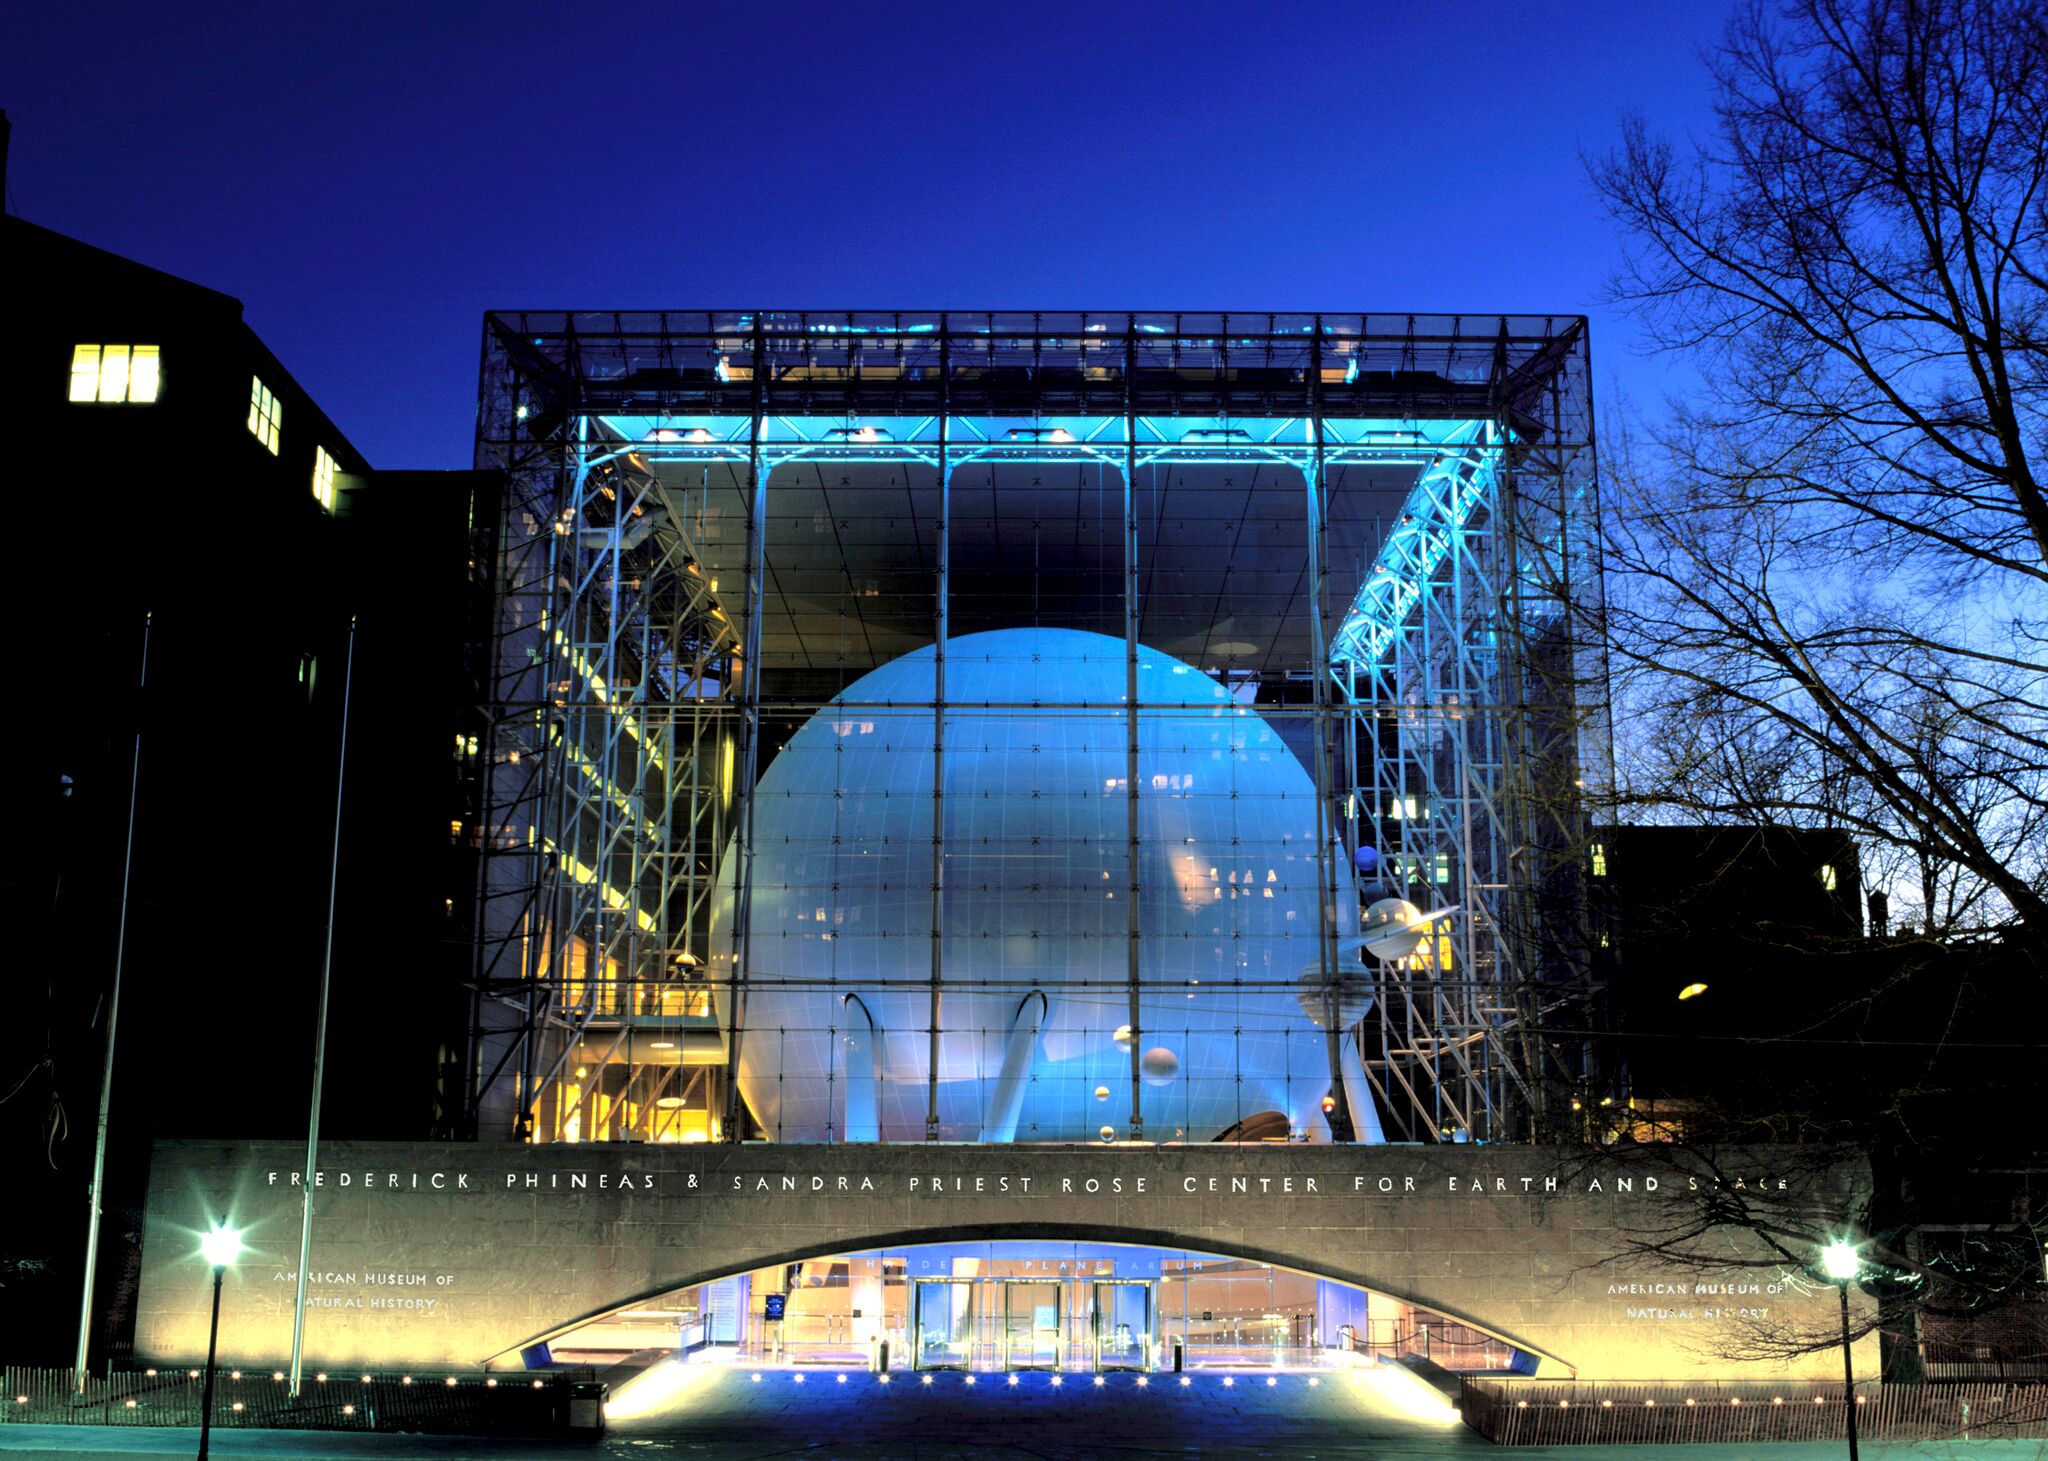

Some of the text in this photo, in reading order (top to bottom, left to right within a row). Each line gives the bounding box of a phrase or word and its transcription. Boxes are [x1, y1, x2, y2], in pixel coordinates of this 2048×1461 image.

[268, 1172, 469, 1188] FREDERICK
[506, 1173, 654, 1189] PHINEAS
[687, 1173, 699, 1188] &
[733, 1176, 875, 1191] SANDRA
[909, 1177, 1032, 1192] PRIEST
[1062, 1177, 1147, 1193] ROSE
[1183, 1177, 1318, 1193] CENTER
[1354, 1176, 1416, 1192] FOR
[1449, 1176, 1558, 1192] EARTH
[1588, 1177, 1659, 1192] AND
[866, 1259, 1202, 1271] HAYDE PLANETARIUM
[273, 1272, 454, 1286] AMRICAN MUSEUM OF
[1607, 1283, 1784, 1295] AMERICAN MUSEUM OF
[303, 1295, 436, 1310] ATURAL HISTORY
[1627, 1308, 1695, 1320] NATURAL
